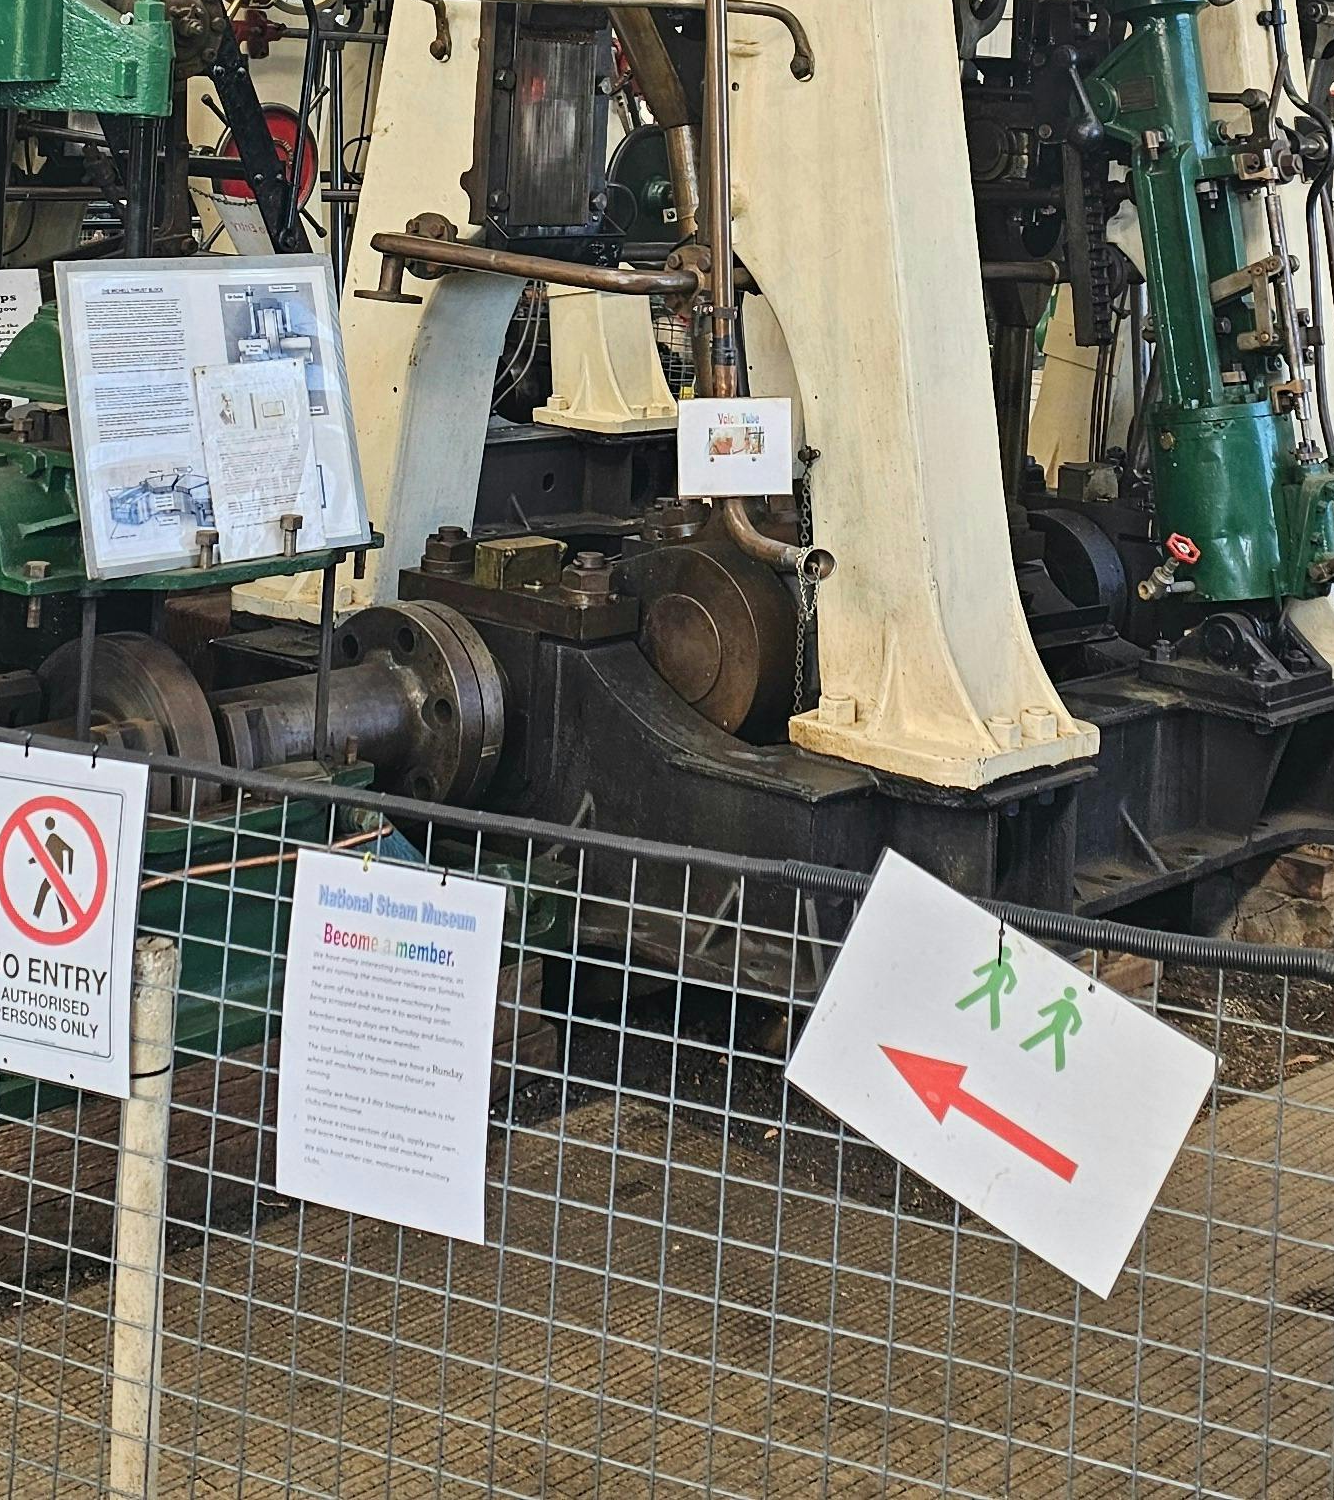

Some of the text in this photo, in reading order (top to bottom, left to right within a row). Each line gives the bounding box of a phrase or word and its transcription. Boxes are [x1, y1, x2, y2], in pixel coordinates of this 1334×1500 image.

[717, 412, 760, 425] Voic Tube
[318, 884, 477, 933] National Steam Museum
[323, 923, 455, 968] Become a member.
[28, 957, 107, 996] ENTRY
[334, 969, 358, 979] running
[311, 980, 321, 988] The
[344, 986, 354, 994] the
[356, 989, 368, 997] club
[1, 986, 90, 1017] AUTHORISED
[358, 1002, 370, 1011] and
[406, 1012, 431, 1023] working
[60, 1018, 99, 1039] ONLY
[336, 1016, 361, 1027] working
[391, 1027, 419, 1039] Thursday
[421, 1032, 433, 1040] and
[367, 1034, 376, 1042] the
[364, 1053, 374, 1061] the
[432, 1066, 463, 1081] Runday
[391, 1072, 403, 1080] and
